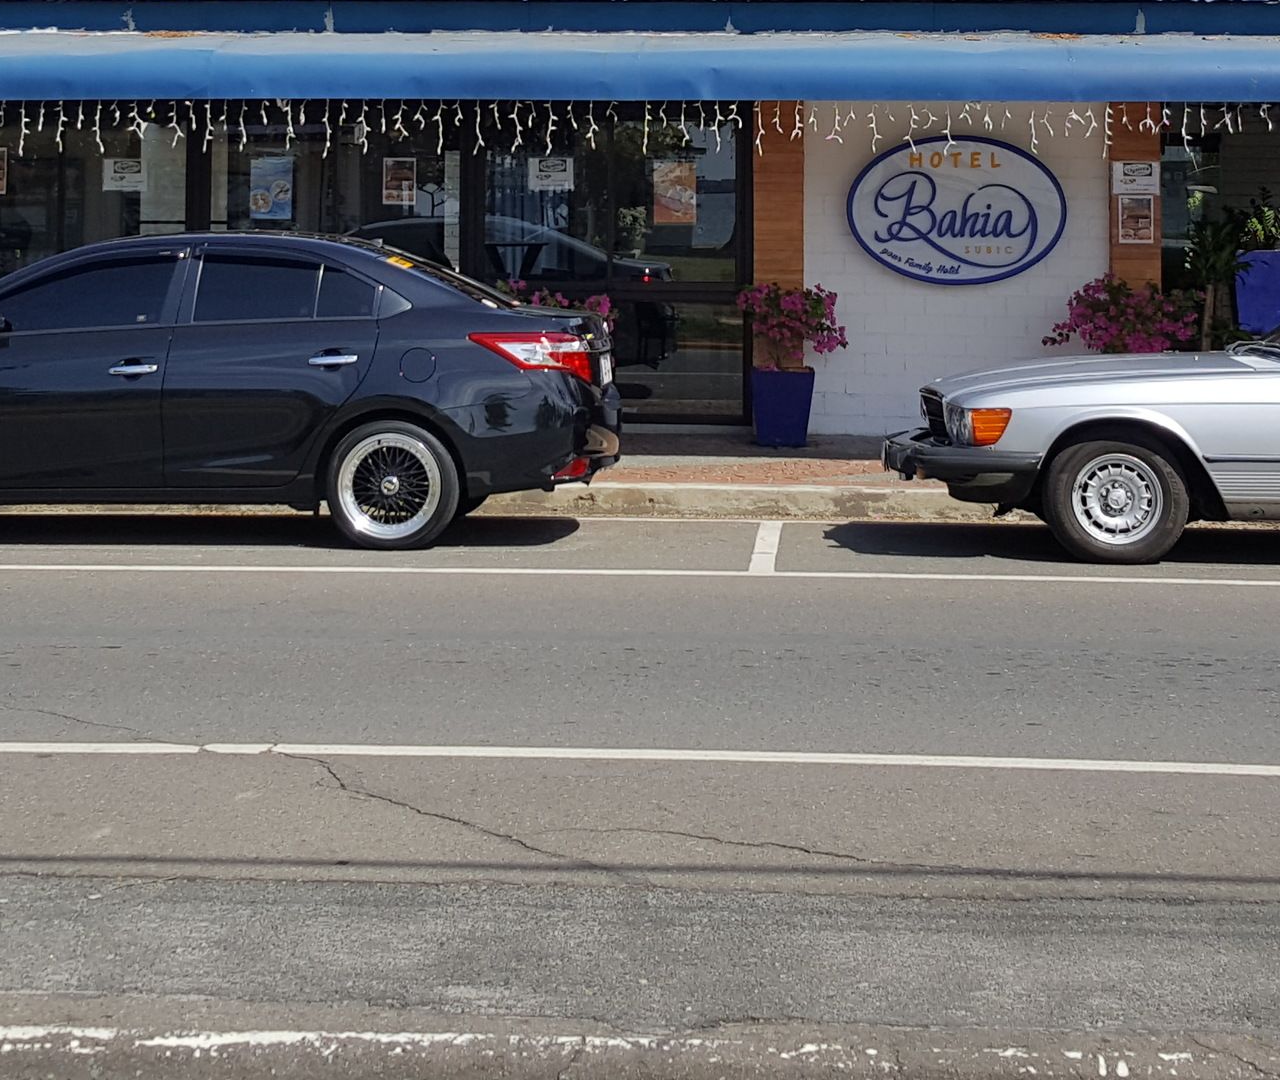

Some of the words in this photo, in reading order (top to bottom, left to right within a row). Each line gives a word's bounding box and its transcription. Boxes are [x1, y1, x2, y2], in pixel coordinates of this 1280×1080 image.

[909, 152, 1001, 168] HOTEL
[874, 171, 1038, 268] Bahia
[964, 245, 1013, 254] SUBIC
[904, 257, 933, 274] Family
[936, 264, 961, 275] Hotel
